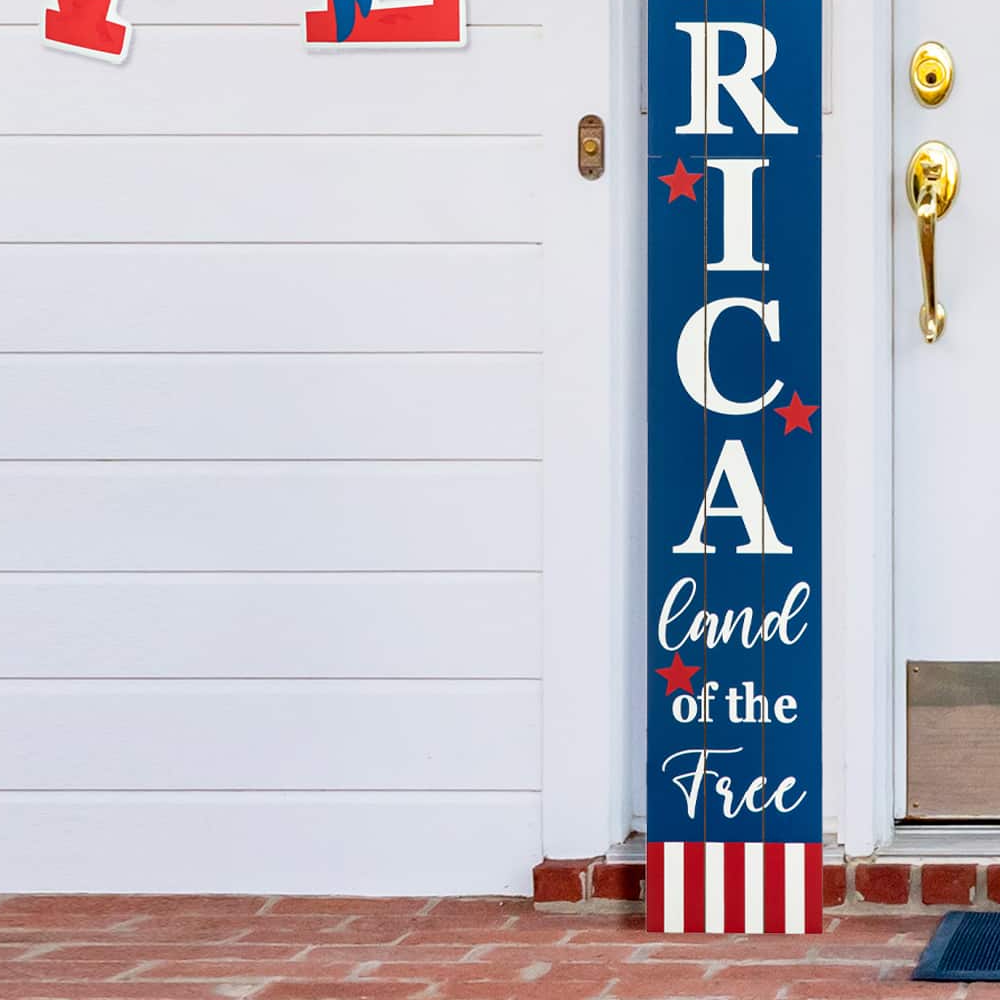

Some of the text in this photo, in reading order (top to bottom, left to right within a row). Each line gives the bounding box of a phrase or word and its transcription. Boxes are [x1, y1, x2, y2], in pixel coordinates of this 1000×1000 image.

[657, 576, 811, 652] land
[672, 681, 798, 724] of the
[661, 746, 807, 819] Free
